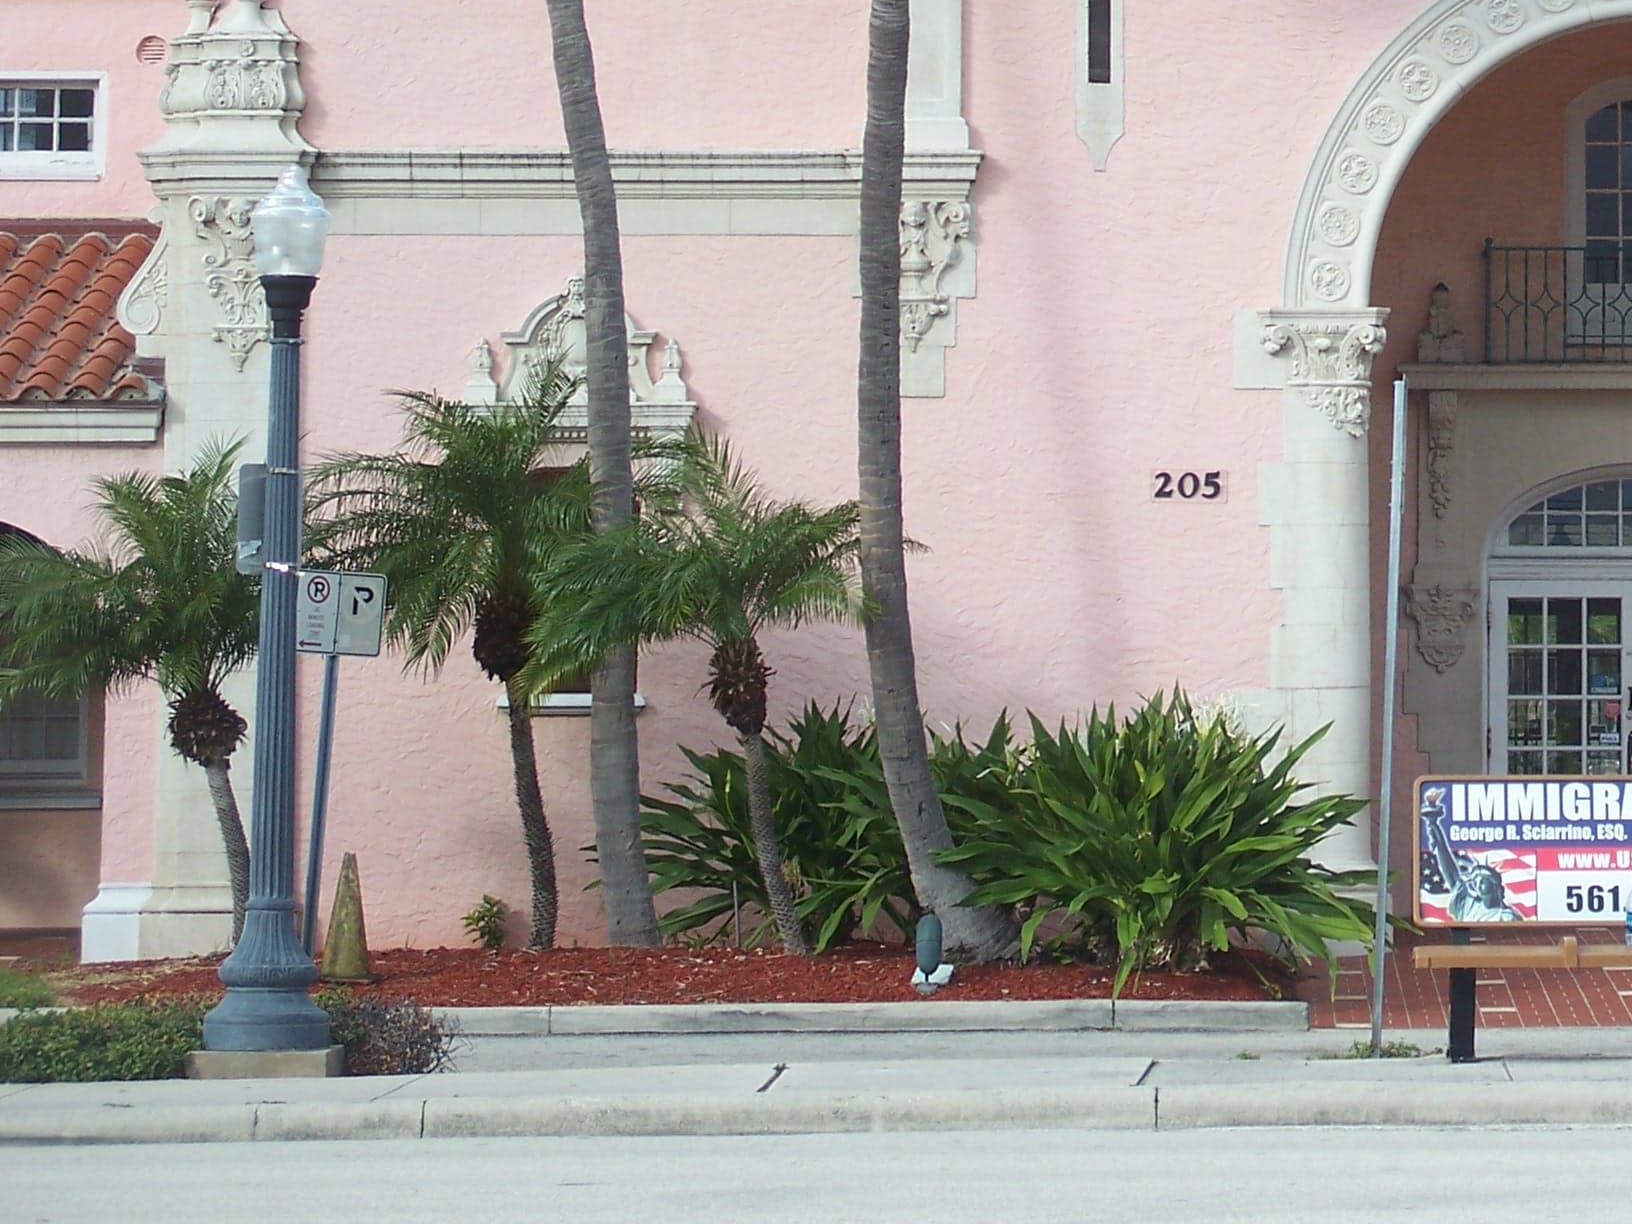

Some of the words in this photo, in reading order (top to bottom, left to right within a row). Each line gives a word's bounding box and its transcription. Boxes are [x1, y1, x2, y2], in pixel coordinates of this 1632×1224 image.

[1154, 470, 1221, 499] 205
[1450, 825, 1503, 842] George
[1506, 825, 1520, 841] R.
[1522, 824, 1595, 842] Sciarrino,
[1597, 824, 1628, 842] ESQ.
